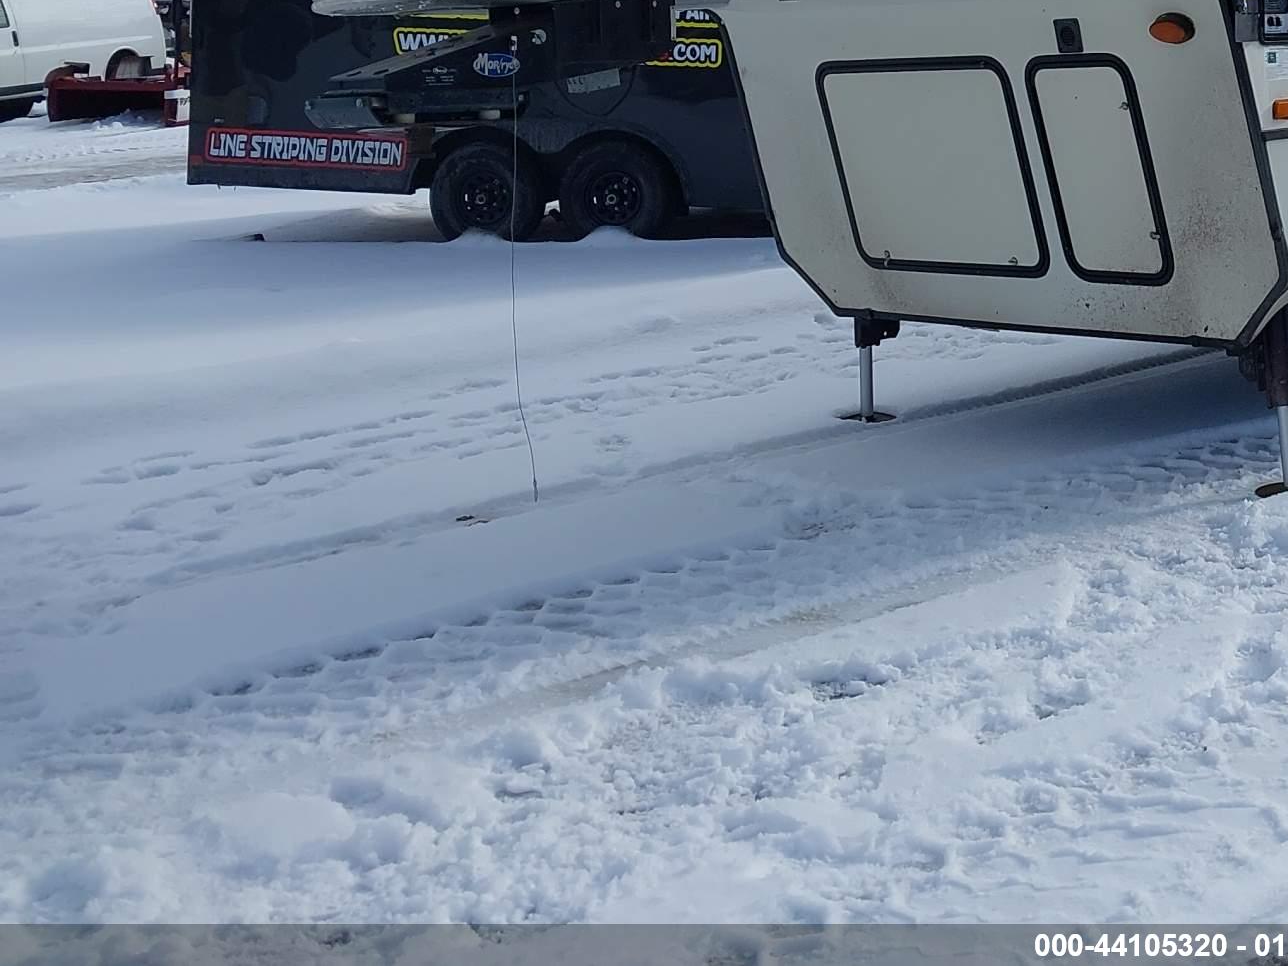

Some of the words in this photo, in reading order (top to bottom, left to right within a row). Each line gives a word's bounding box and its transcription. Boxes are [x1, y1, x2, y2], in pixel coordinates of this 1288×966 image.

[209, 132, 246, 157] LINE
[250, 135, 328, 162] STRIPING
[330, 139, 403, 166] DIVISION
